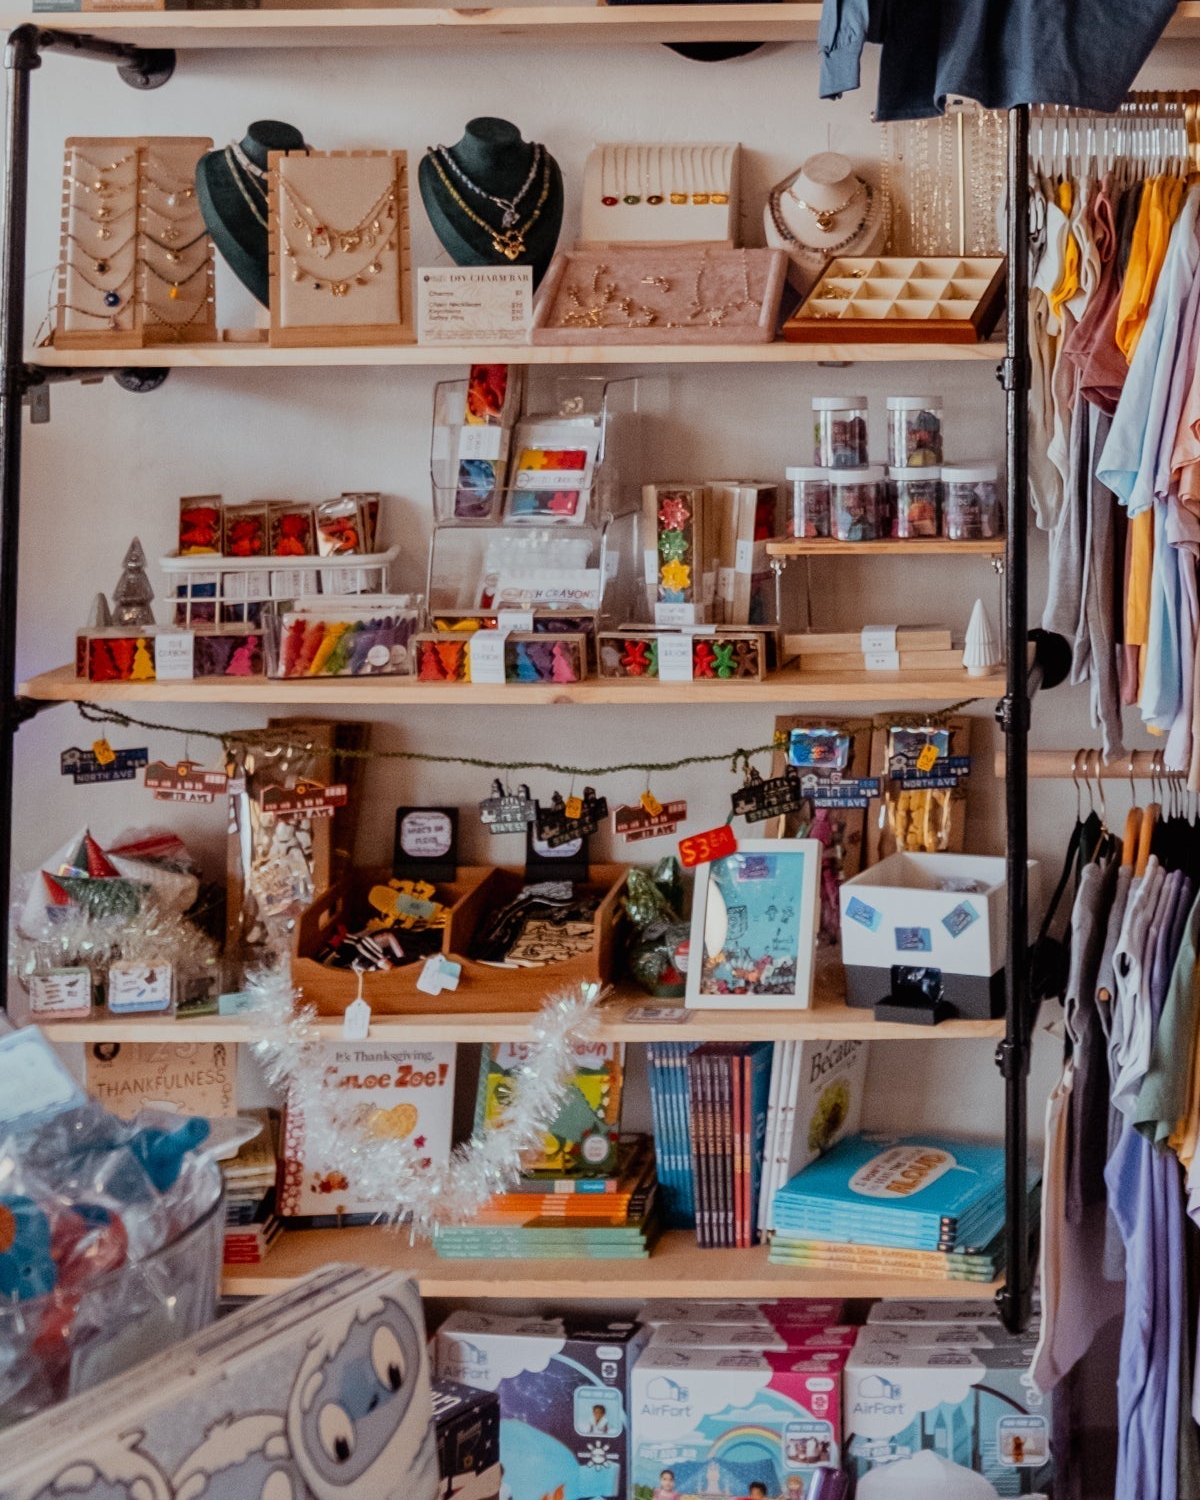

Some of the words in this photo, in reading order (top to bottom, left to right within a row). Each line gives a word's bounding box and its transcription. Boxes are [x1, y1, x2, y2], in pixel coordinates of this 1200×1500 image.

[76, 772, 110, 782] NORTH
[113, 770, 134, 779] AVE
[903, 779, 934, 788] NORTH
[936, 777, 957, 786] AVE
[815, 799, 845, 807] NORTH
[847, 799, 867, 807] AVE
[97, 1069, 226, 1097] THANKFULNESS
[641, 1404, 691, 1418] AirFort
[853, 1403, 904, 1415] AirFort
